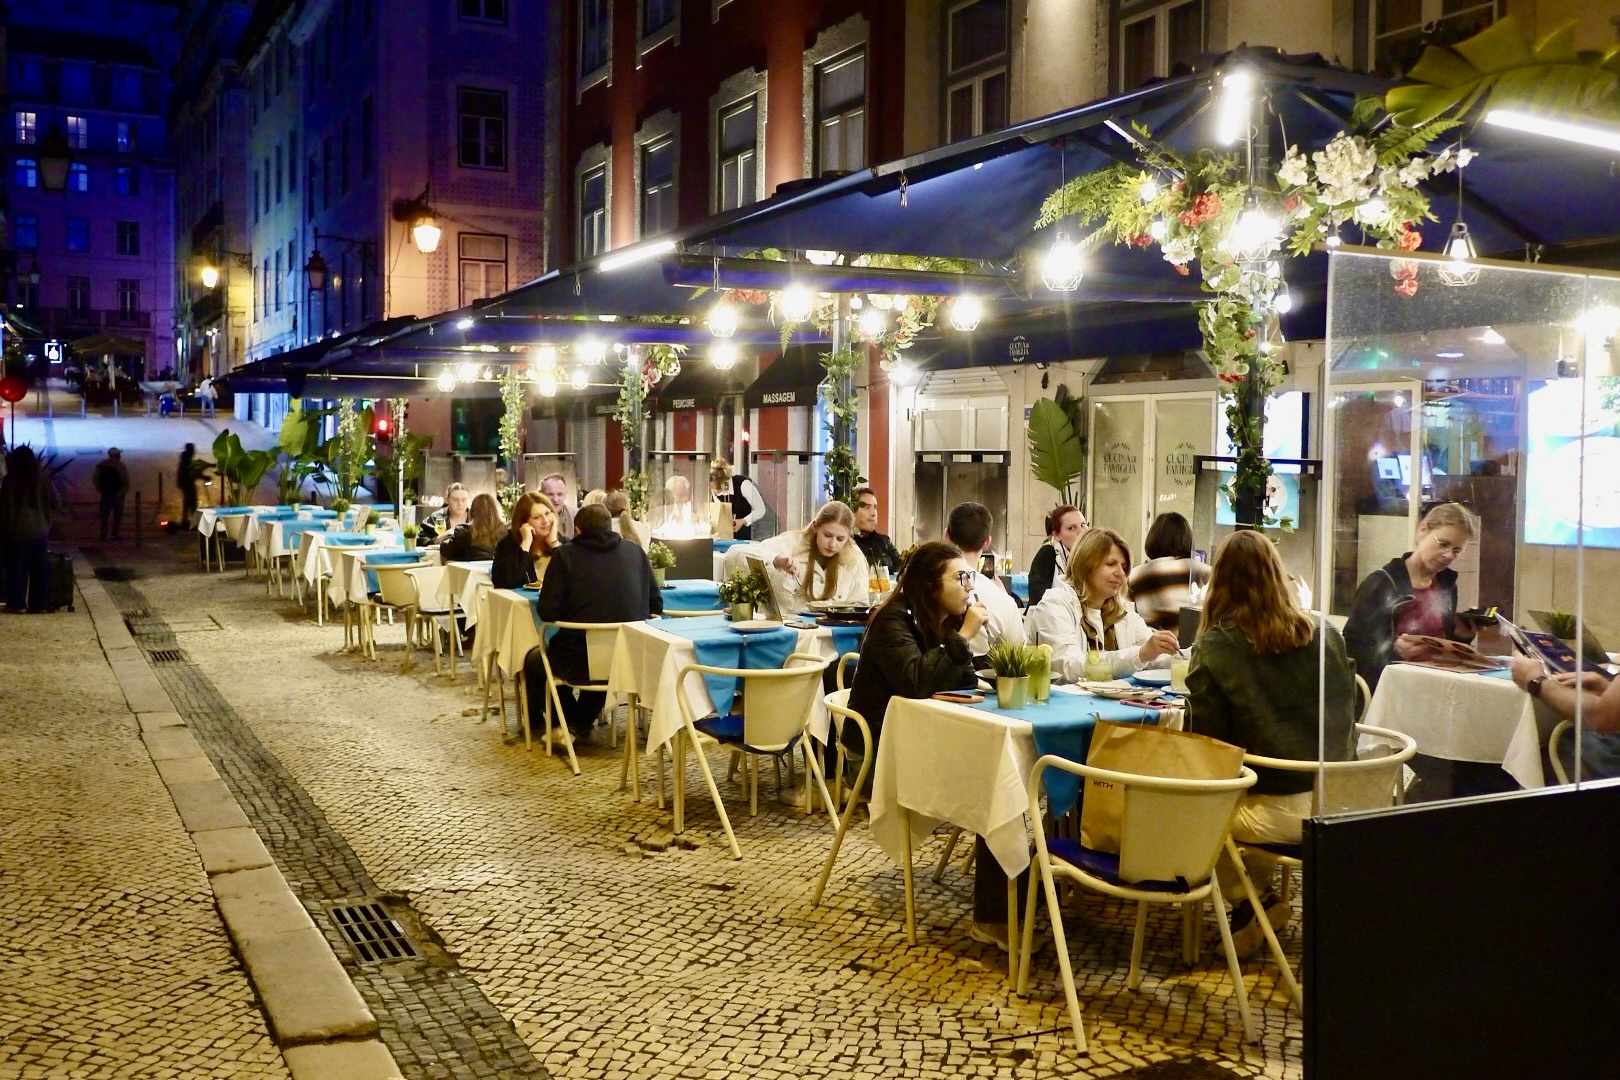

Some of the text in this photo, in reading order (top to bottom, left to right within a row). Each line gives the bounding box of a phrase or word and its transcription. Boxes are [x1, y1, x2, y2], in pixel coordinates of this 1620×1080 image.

[762, 391, 796, 404] MASSAGEM
[672, 398, 695, 408] PEDICURE
[1103, 452, 1131, 463] CUCINA
[1166, 453, 1193, 463] CUCIN
[1103, 463, 1137, 473] FAMIGLIA
[1094, 780, 1113, 789] WITH
